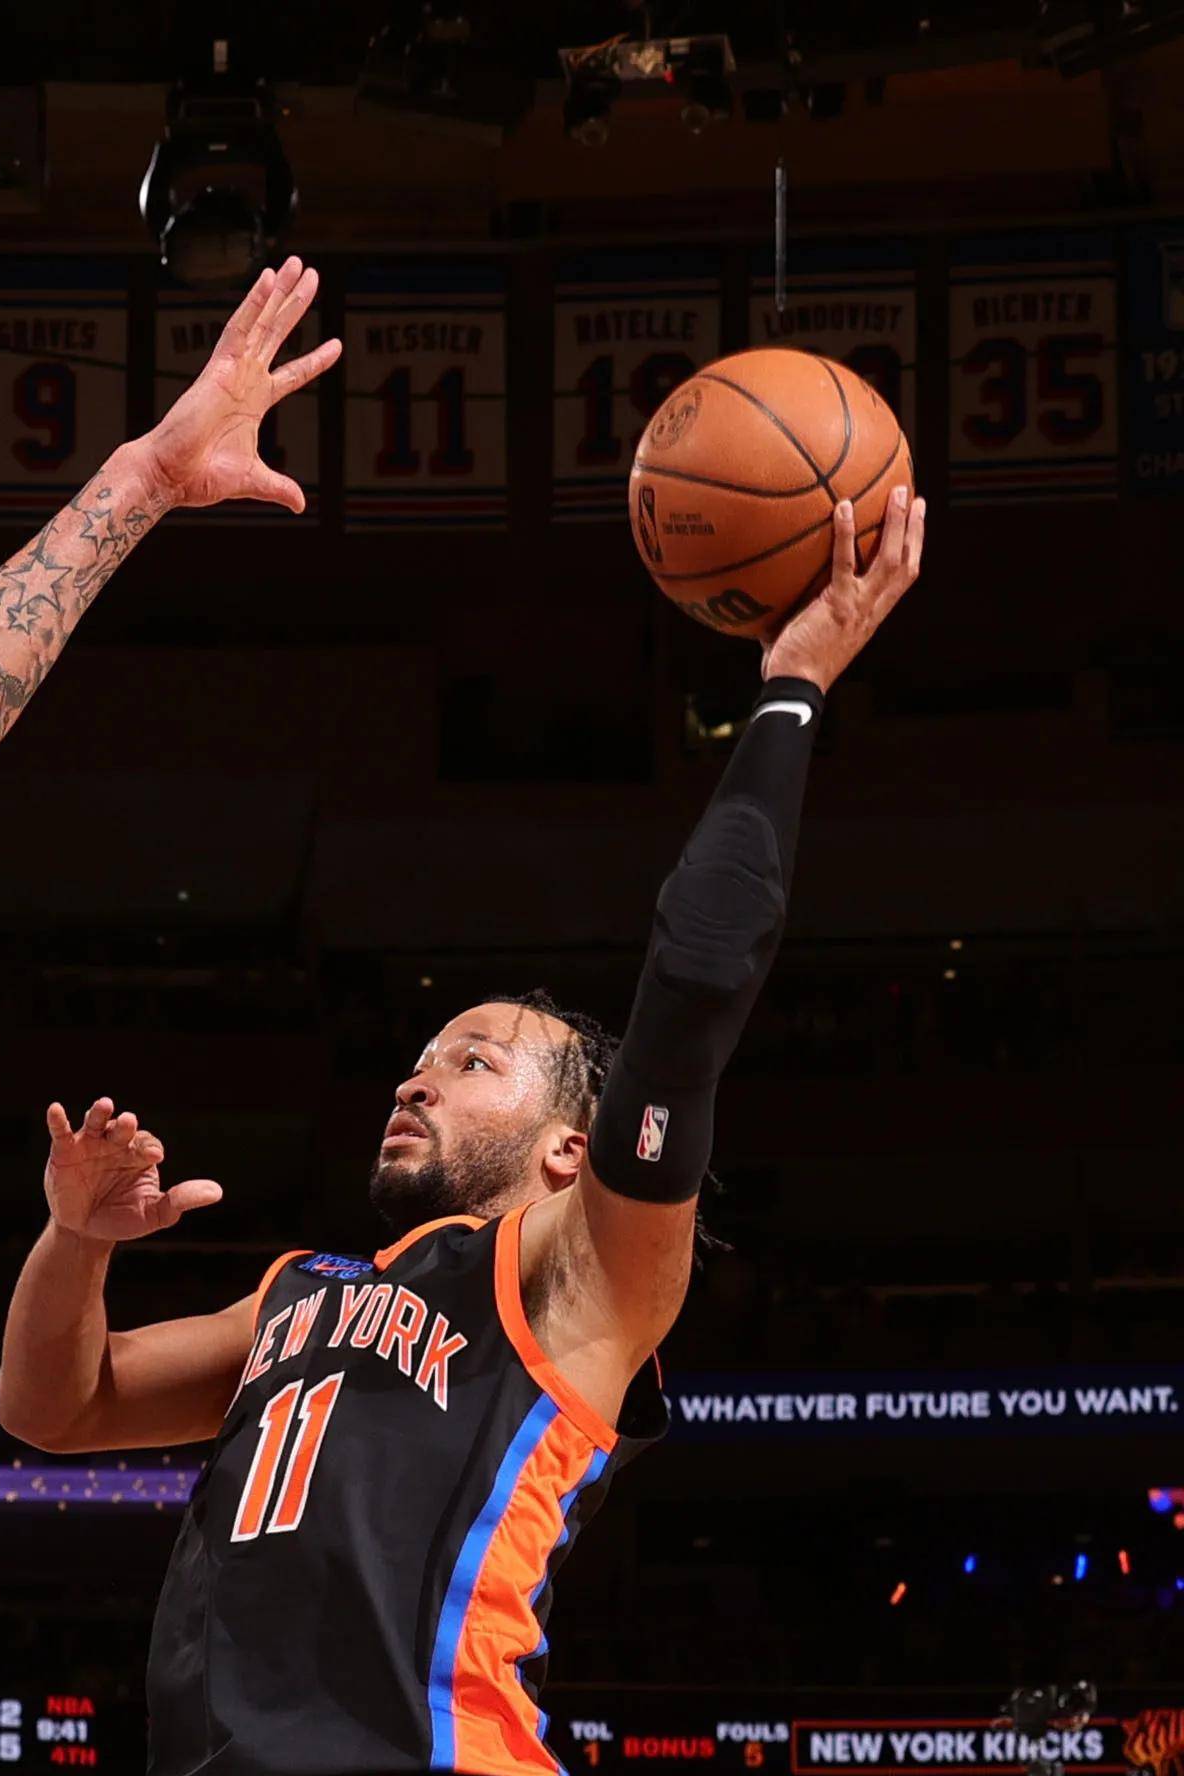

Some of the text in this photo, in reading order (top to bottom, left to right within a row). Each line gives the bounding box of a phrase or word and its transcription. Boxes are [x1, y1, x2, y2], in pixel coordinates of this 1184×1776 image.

[367, 322, 482, 355] MESSIER
[574, 309, 698, 346] RATELLE
[962, 334, 1103, 448] 35
[12, 361, 77, 470] 9
[377, 365, 474, 476] 11
[327, 1284, 468, 1411] YORK
[679, 1387, 1179, 1421] WHATEVER FUTURE YOU WANT.
[230, 1371, 345, 1542] 11
[571, 1721, 614, 1740] TOL
[623, 1737, 715, 1758] BONUS
[716, 1723, 789, 1741] FOULS
[811, 1733, 885, 1762] NEW
[890, 1731, 977, 1762] YORK
[51, 1746, 97, 1766] 4TH
